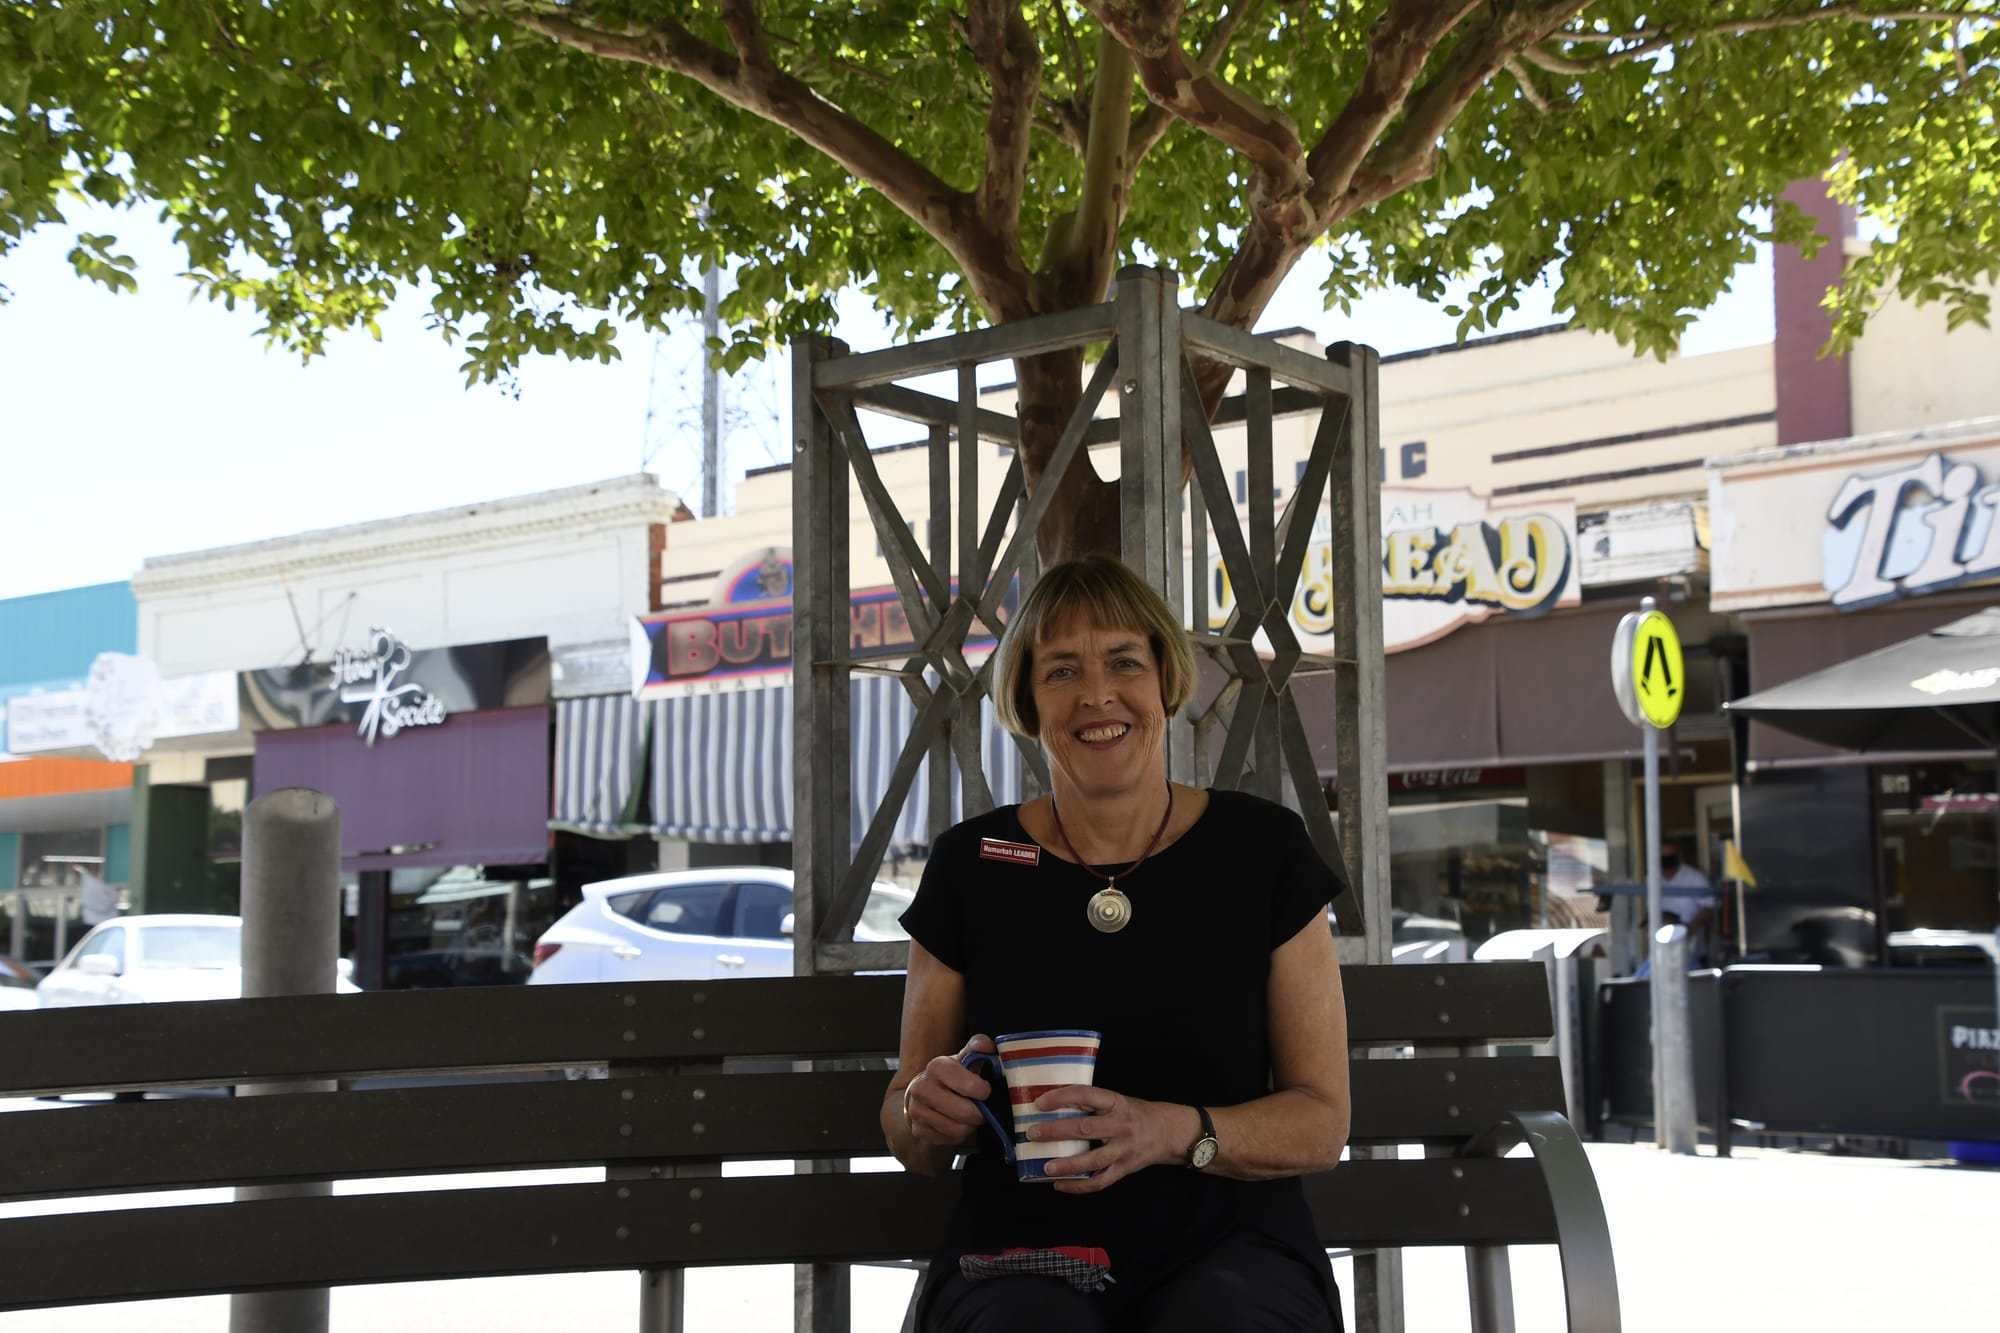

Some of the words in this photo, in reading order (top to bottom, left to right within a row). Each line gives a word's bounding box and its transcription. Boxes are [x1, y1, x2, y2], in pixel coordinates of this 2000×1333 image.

[1294, 513, 1571, 635] BEAD
[329, 649, 378, 690] Hair
[1013, 849, 1036, 859] LEADER
